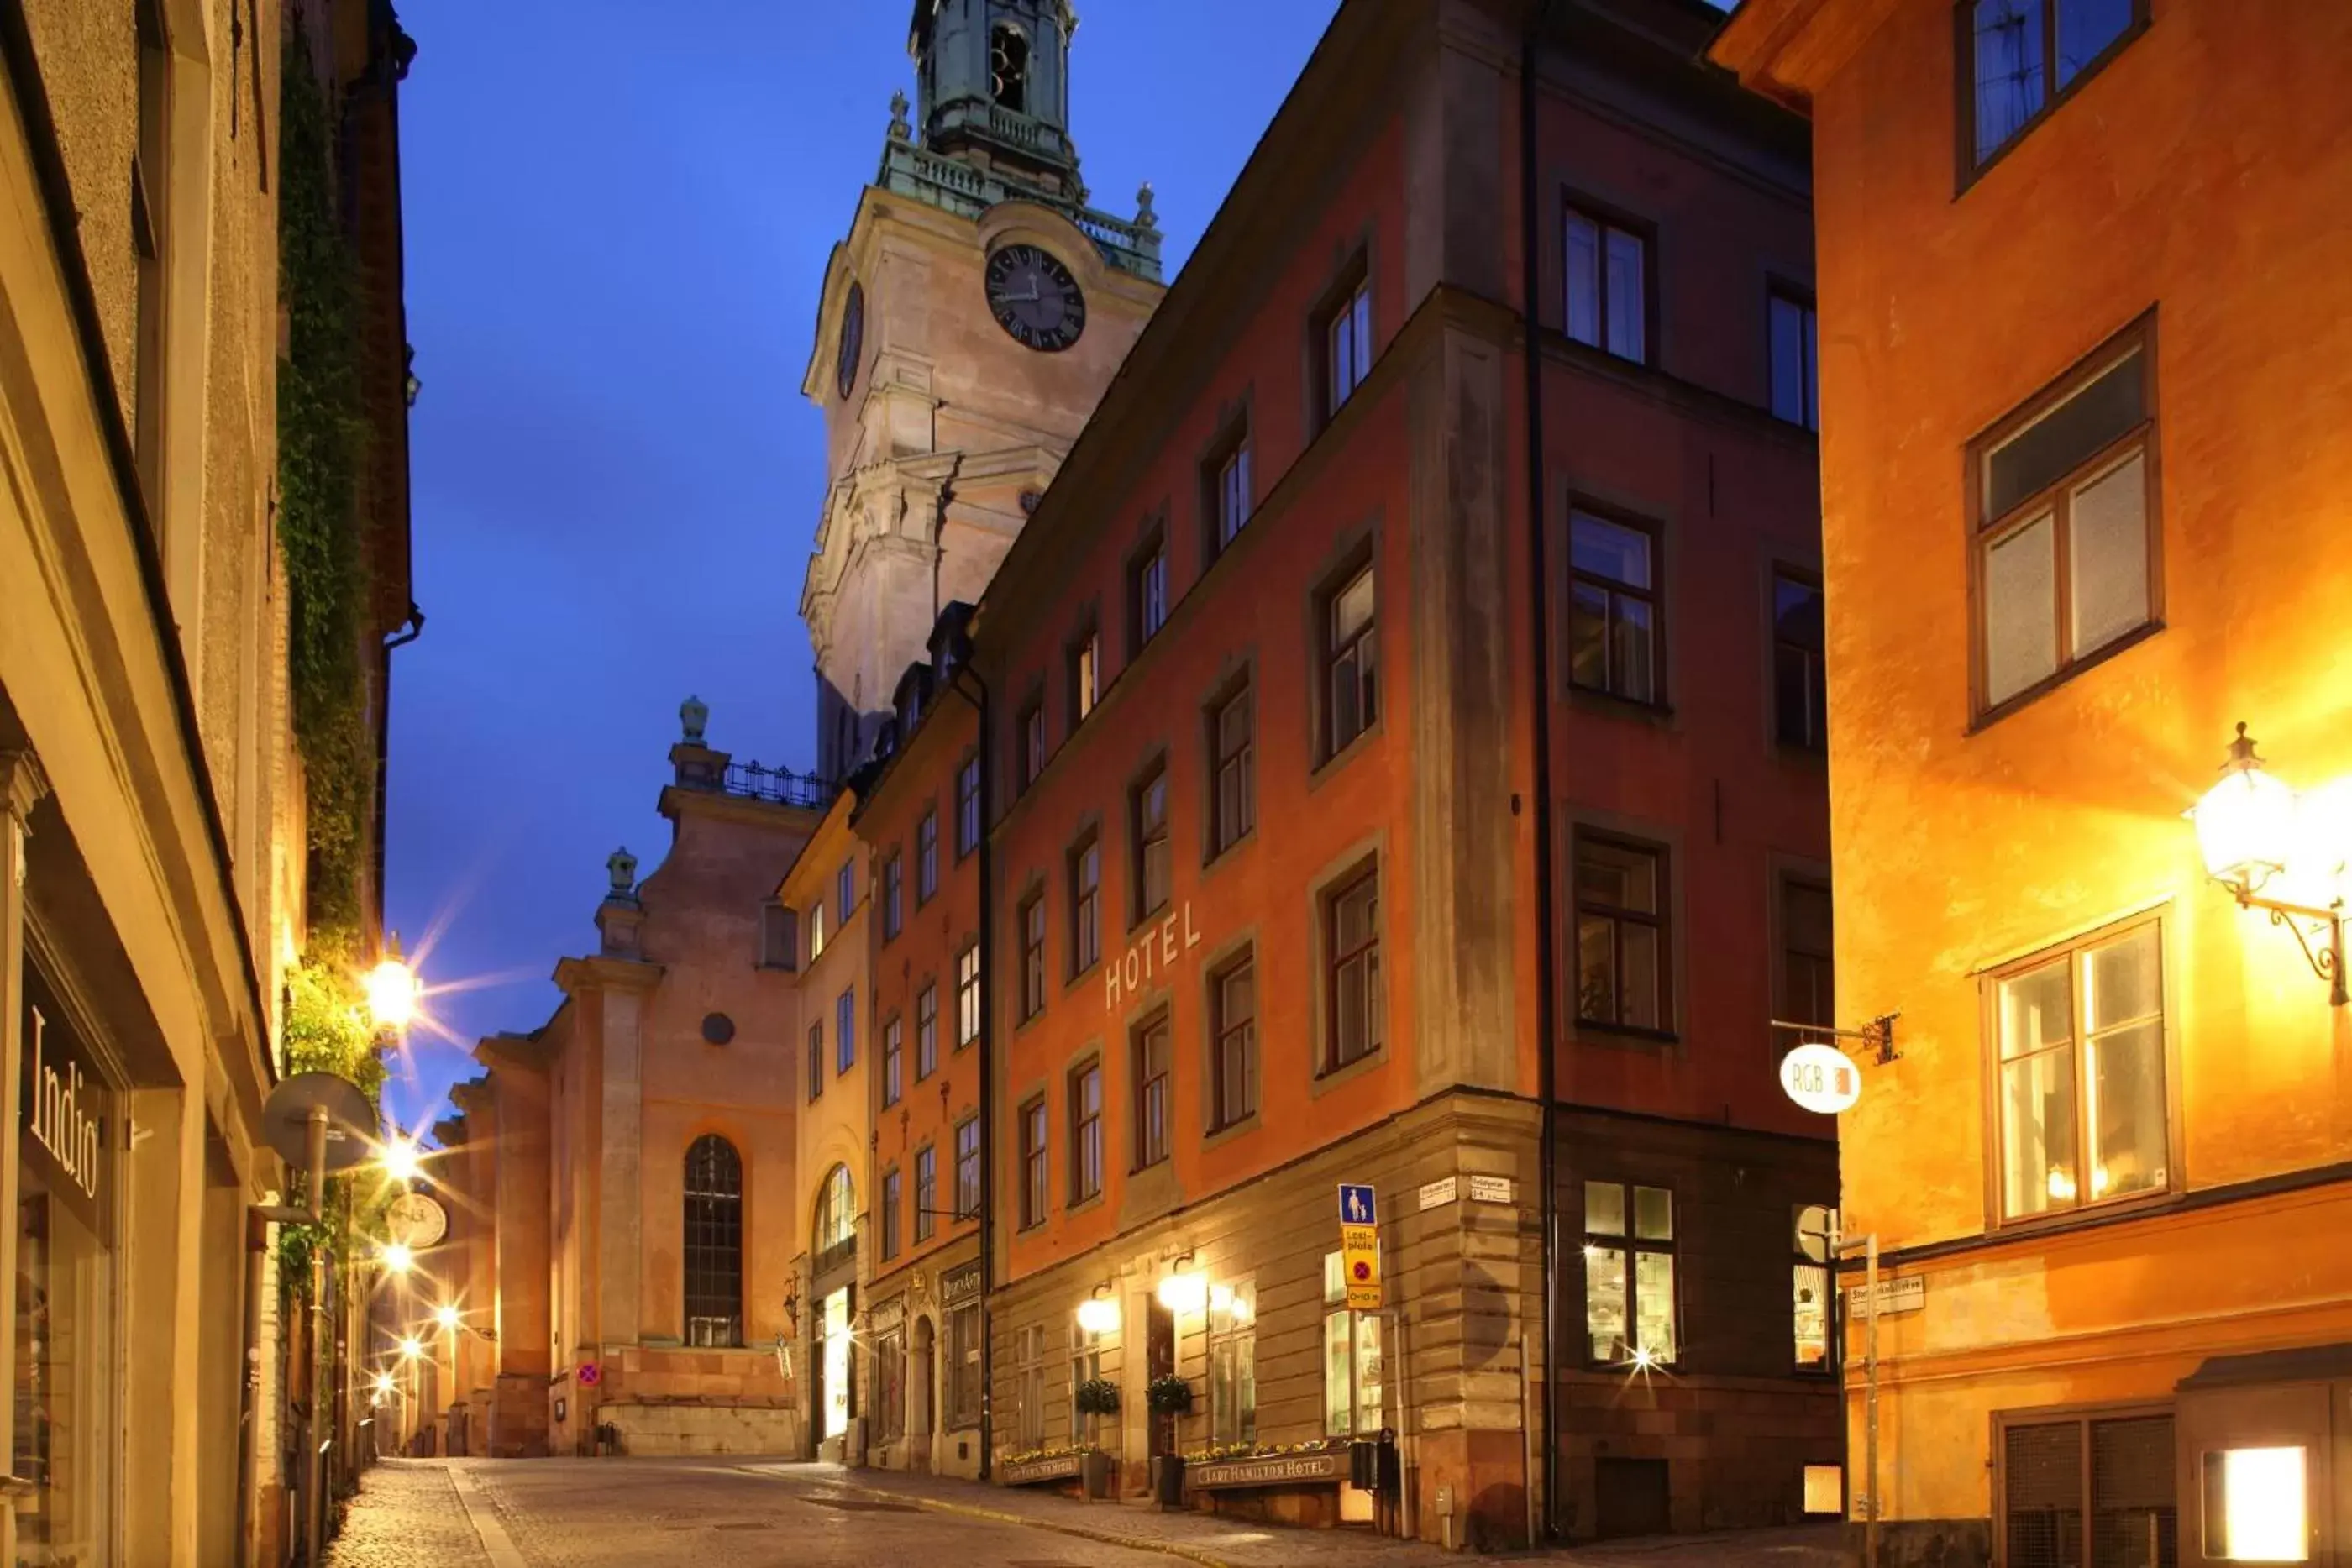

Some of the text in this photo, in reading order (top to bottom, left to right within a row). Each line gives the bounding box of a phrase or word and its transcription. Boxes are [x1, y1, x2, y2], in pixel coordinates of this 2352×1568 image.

[1106, 900, 1200, 1010] HOTEL
[31, 1005, 97, 1199] Indio
[1793, 1063, 1824, 1093] RGB
[1230, 1464, 1284, 1481] HAMILTON
[1287, 1460, 1325, 1476] HOTEL
